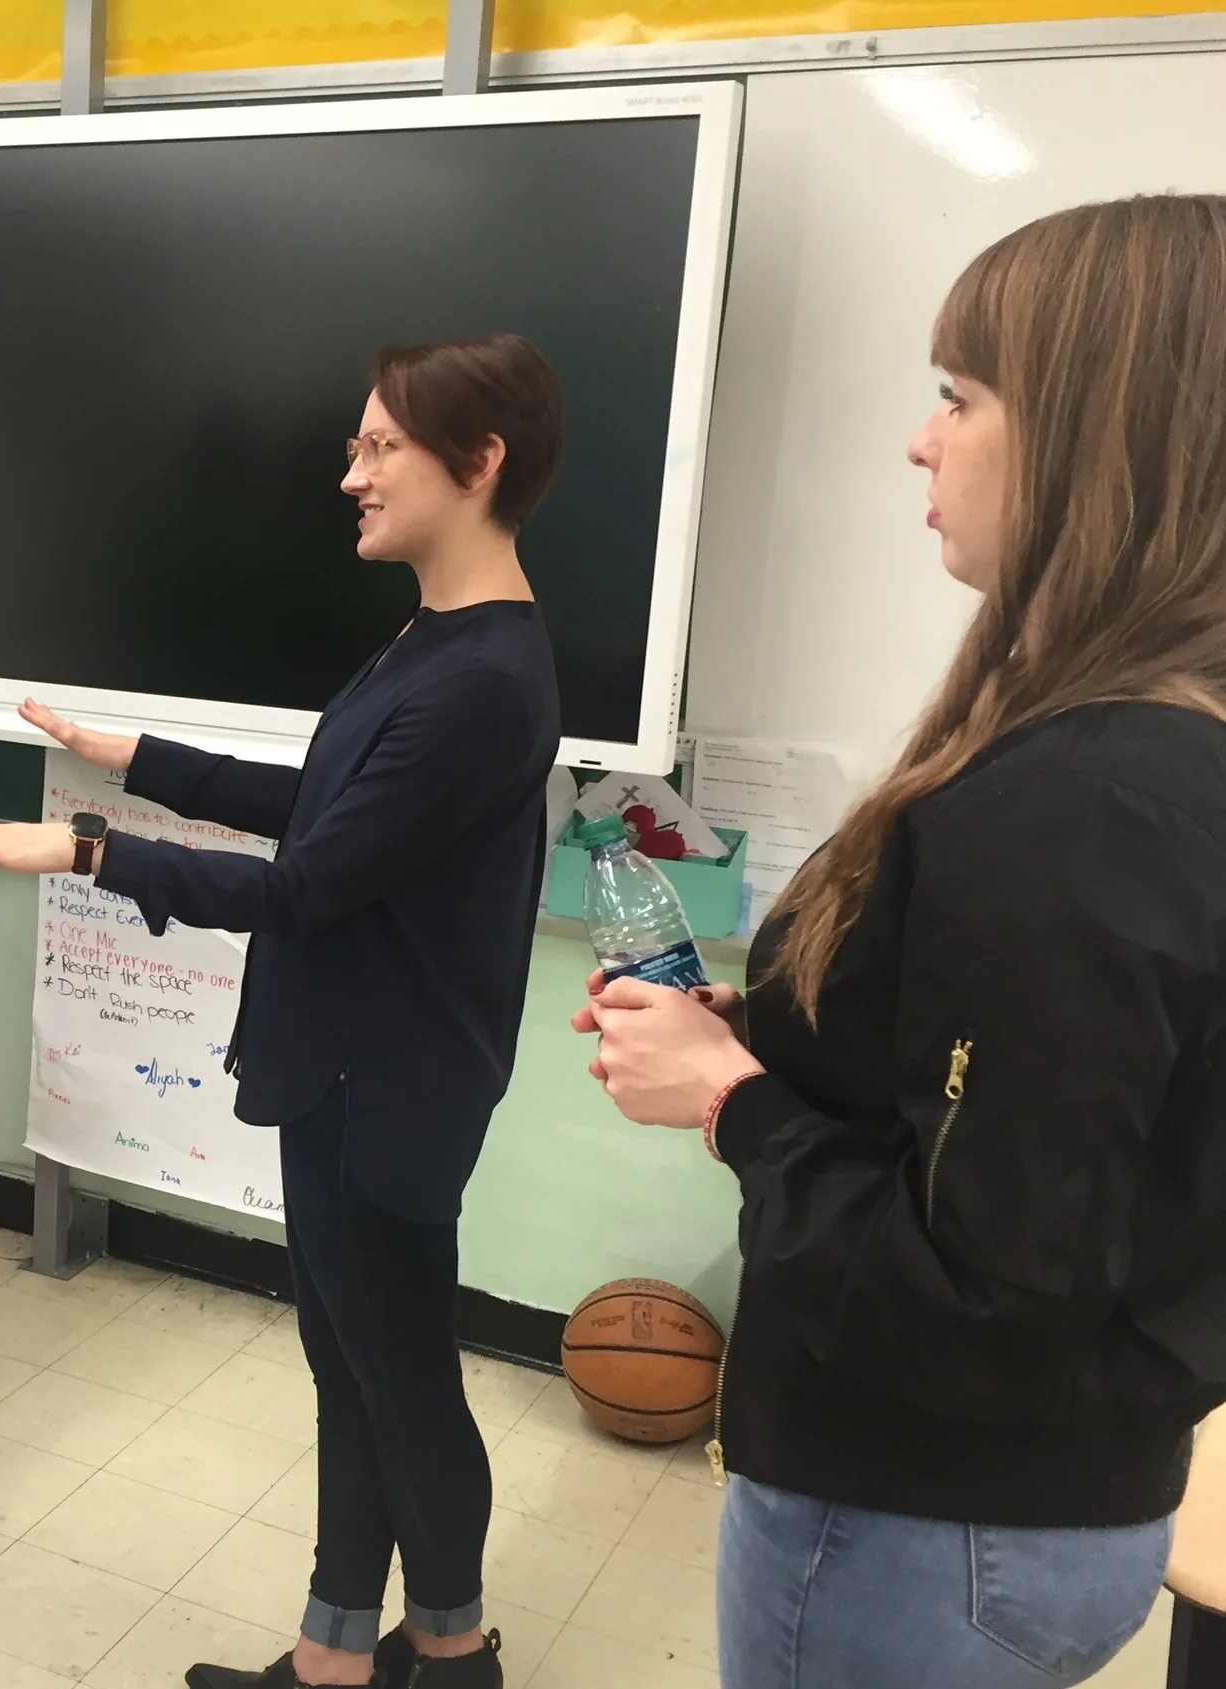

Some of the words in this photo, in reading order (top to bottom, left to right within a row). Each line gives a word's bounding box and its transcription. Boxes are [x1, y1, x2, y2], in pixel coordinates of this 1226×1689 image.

[61, 789, 122, 824] Everybody
[128, 807, 151, 823] has
[153, 812, 170, 826] to
[174, 819, 249, 845] contribute
[60, 895, 108, 920] Respect
[61, 879, 90, 902] Only
[60, 920, 86, 941] One
[58, 939, 102, 965] Accept
[187, 968, 204, 983] no
[210, 974, 236, 990] one
[61, 954, 111, 983] Respect
[120, 964, 143, 987] the
[149, 975, 194, 996] space
[57, 976, 98, 1001] Don't
[109, 992, 143, 1015] Rush
[147, 1004, 196, 1025] people
